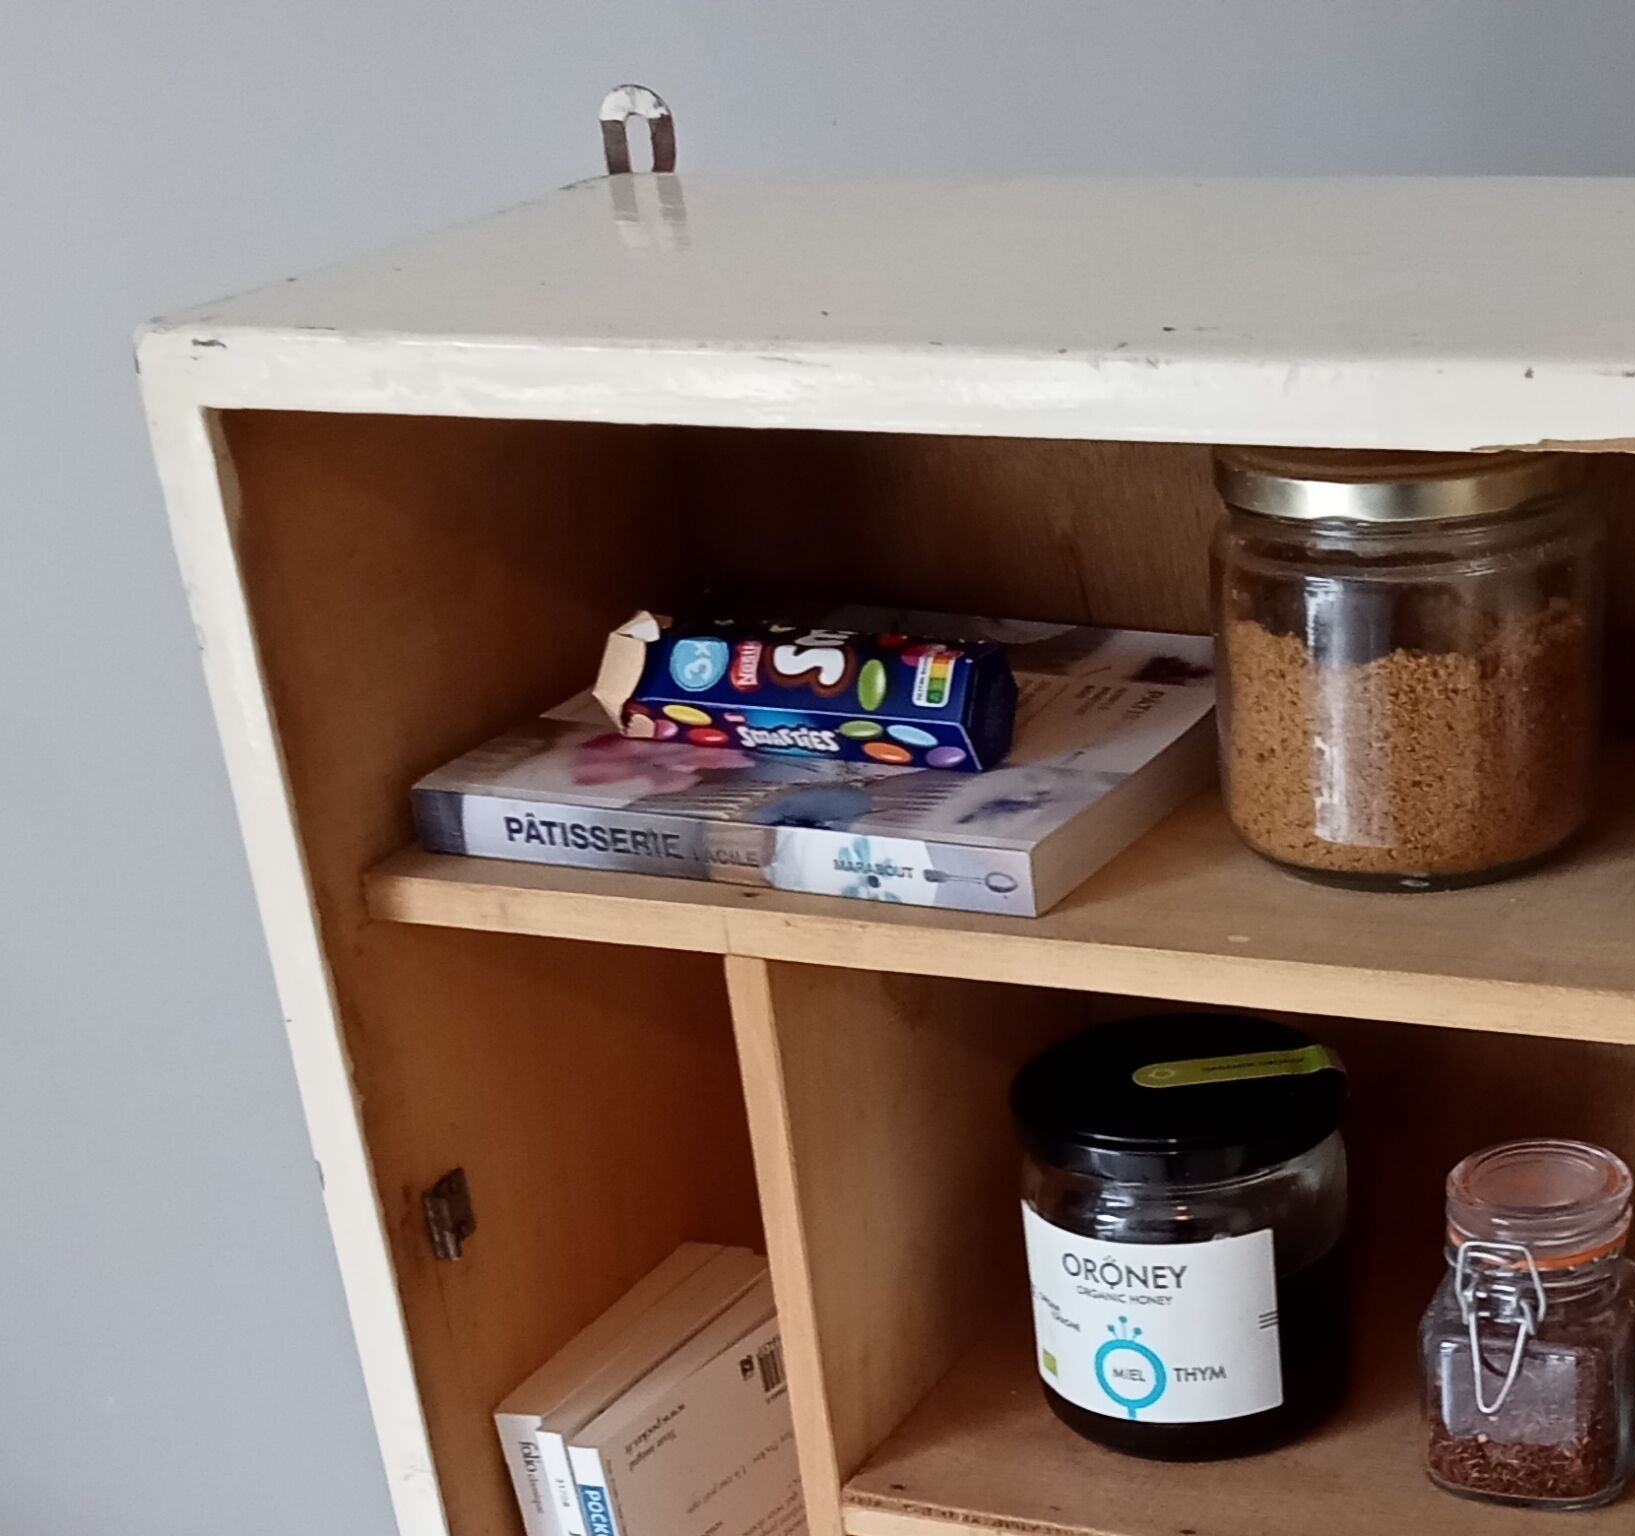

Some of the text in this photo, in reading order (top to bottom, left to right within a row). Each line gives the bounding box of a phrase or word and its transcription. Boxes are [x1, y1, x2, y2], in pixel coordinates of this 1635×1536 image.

[504, 812, 681, 862] PÂTISSERIE
[833, 857, 915, 882] MARABOUT
[1076, 1285, 1173, 1306] ORGANIC HONEY
[1113, 1365, 1228, 1383] MIEL THYM
[519, 1439, 540, 1473] folio
